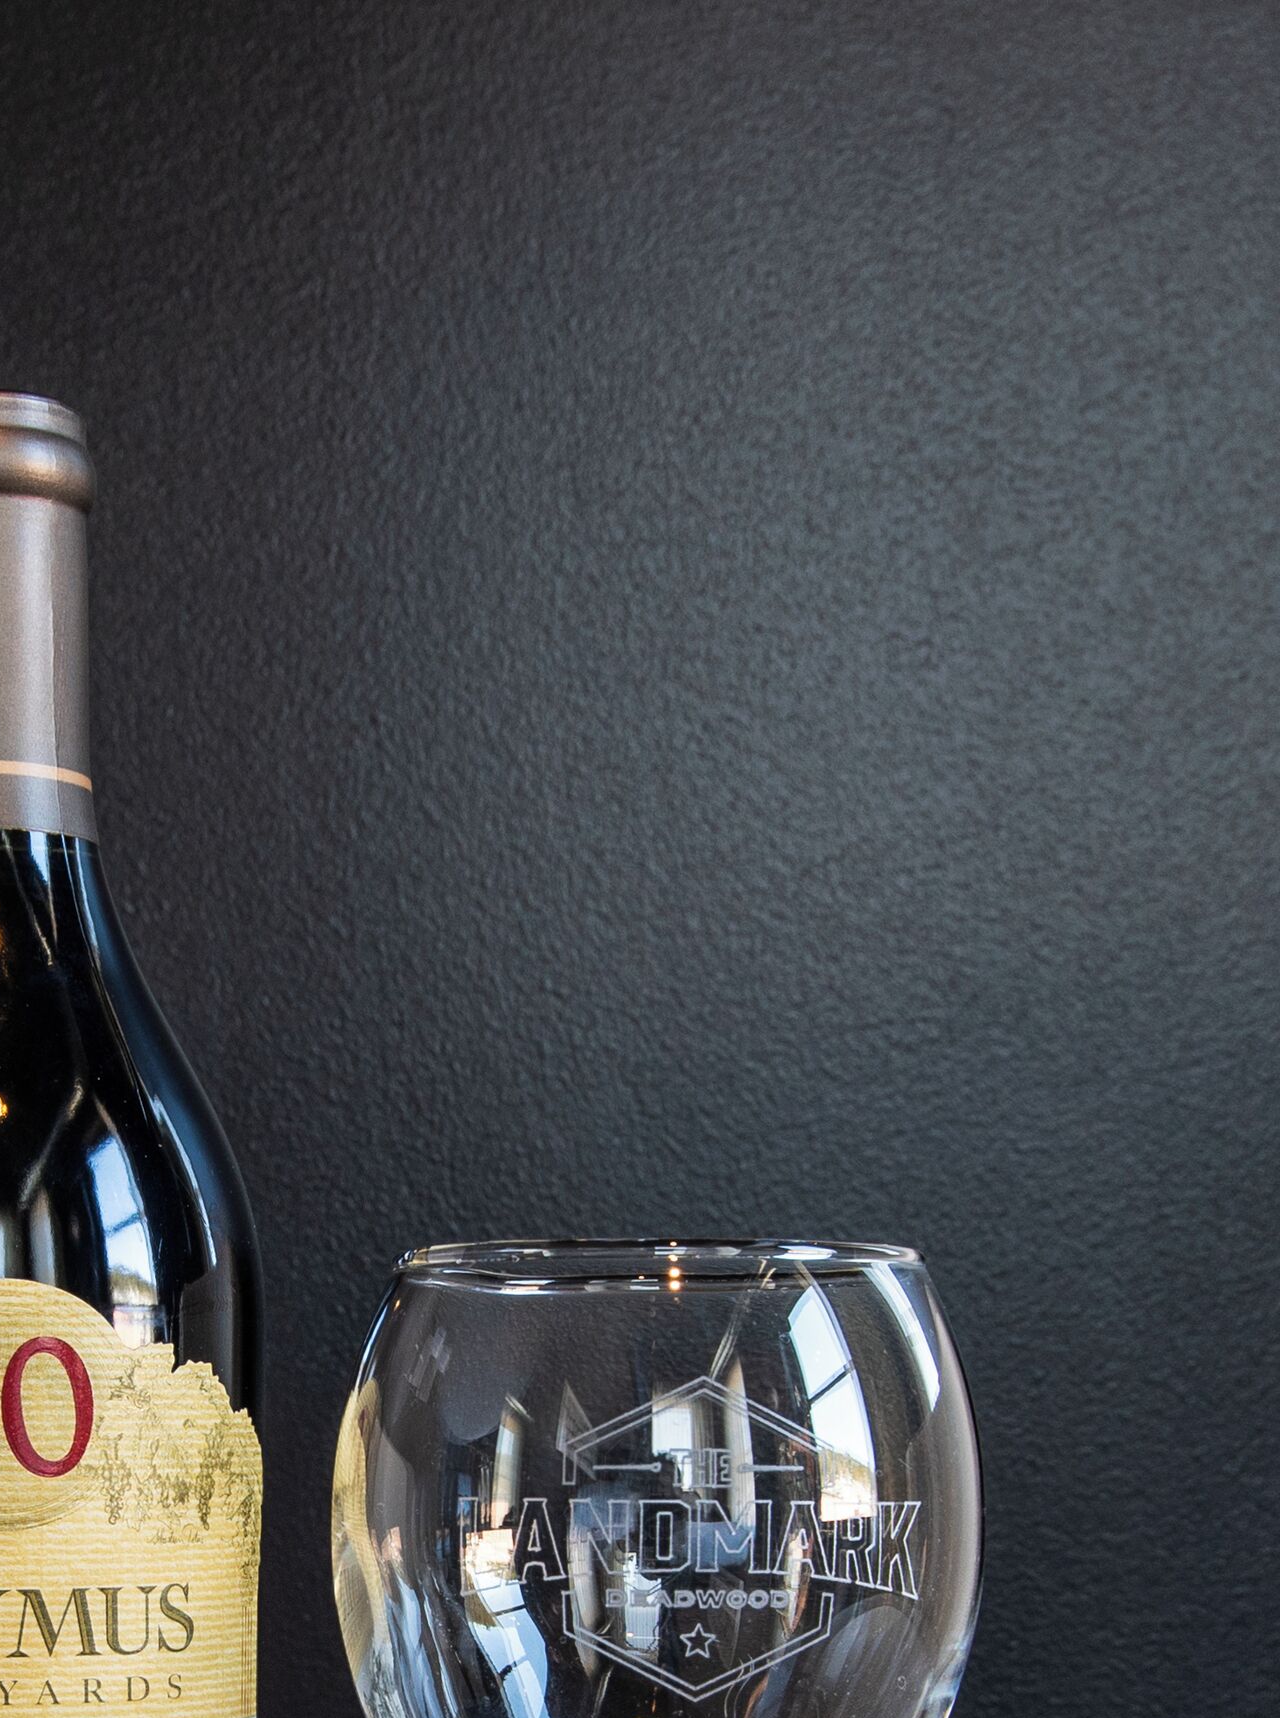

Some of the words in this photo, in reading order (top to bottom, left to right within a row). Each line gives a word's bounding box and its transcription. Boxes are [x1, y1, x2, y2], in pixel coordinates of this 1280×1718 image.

[669, 1448, 737, 1488] THE
[459, 1497, 922, 1600] LANDMARK
[605, 1588, 792, 1609] DEADWOOD
